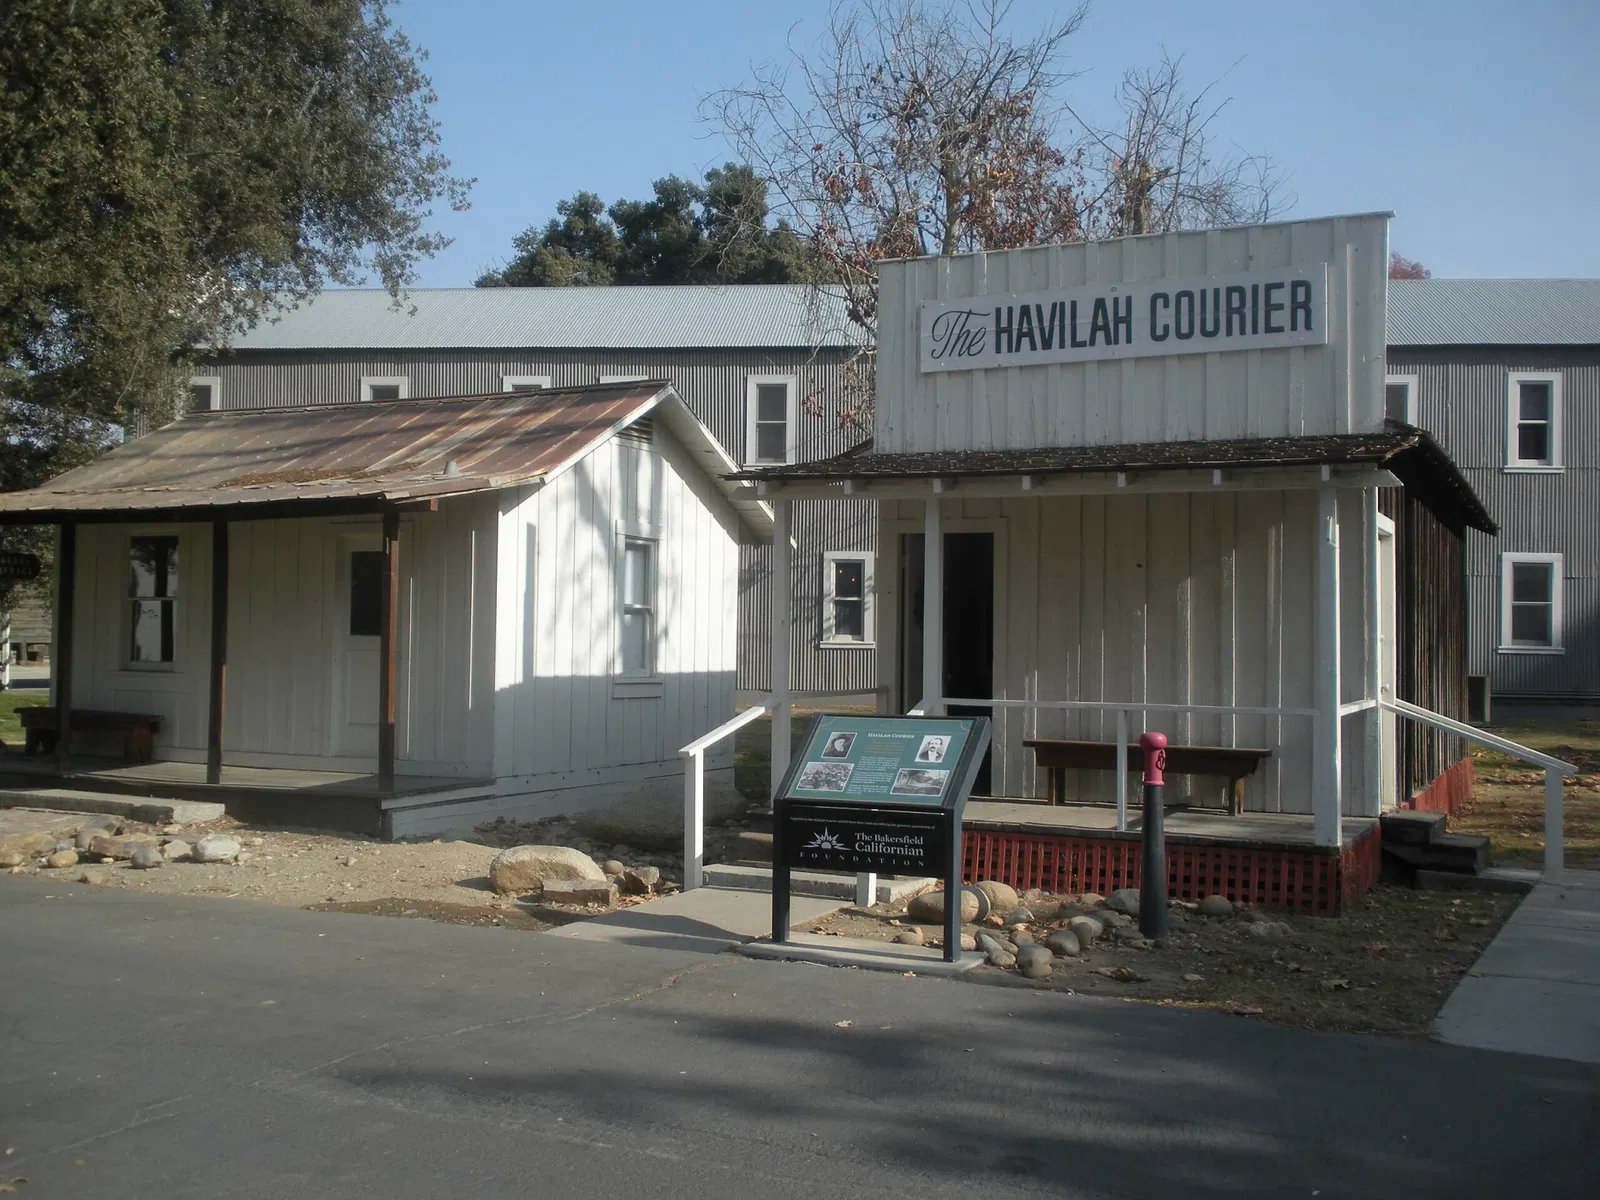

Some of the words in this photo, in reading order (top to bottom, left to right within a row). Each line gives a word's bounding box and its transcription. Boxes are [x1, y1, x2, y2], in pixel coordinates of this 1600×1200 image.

[931, 309, 991, 360] The
[995, 295, 1133, 354] HAVILAH
[1150, 279, 1313, 342] COURIER
[855, 832, 873, 842] The
[874, 833, 924, 845] Bakersfield
[855, 841, 924, 856] Californian
[799, 851, 924, 867] FOUNDATION
